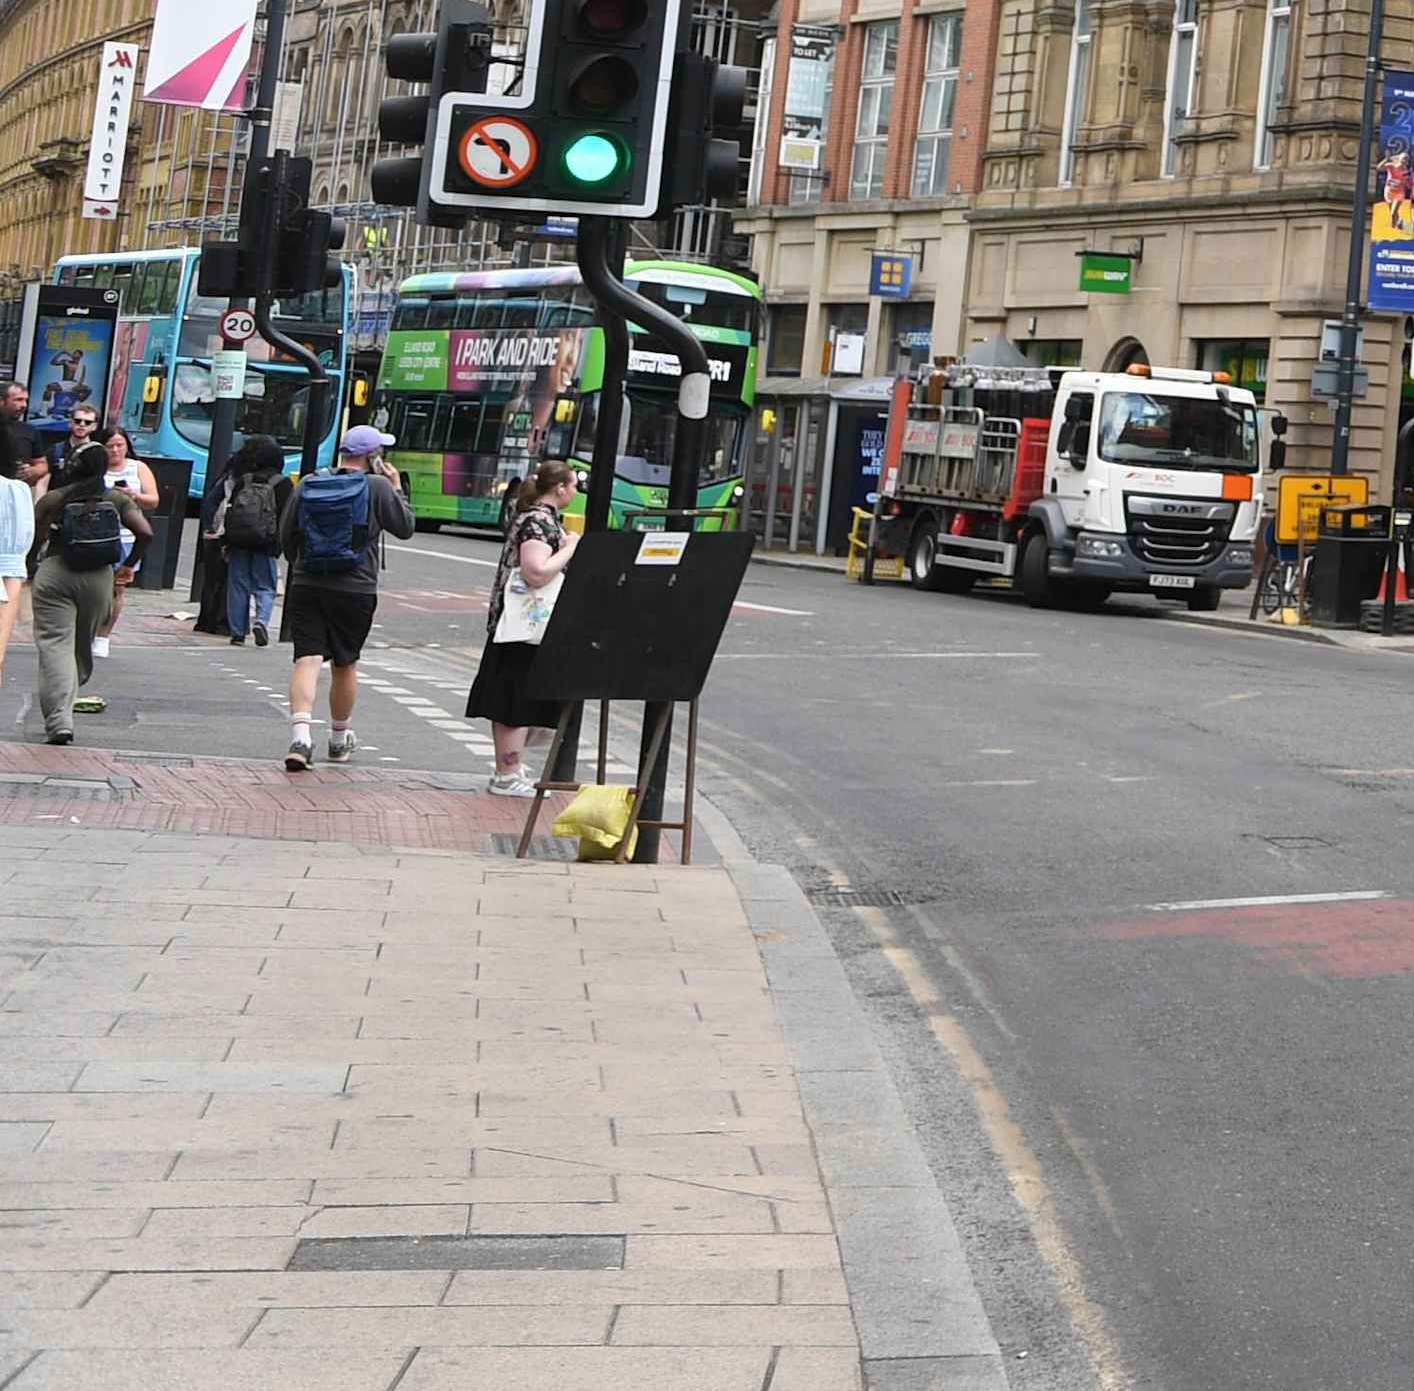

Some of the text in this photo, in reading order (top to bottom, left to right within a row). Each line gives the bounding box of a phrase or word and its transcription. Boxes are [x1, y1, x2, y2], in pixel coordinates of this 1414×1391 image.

[100, 75, 124, 194] MARRIOTT
[1376, 263, 1401, 273] ENTER
[227, 318, 253, 332] 20
[461, 338, 499, 366] PARK
[495, 337, 528, 366] AND
[526, 337, 561, 366] RIDE
[1163, 504, 1203, 514] DAF
